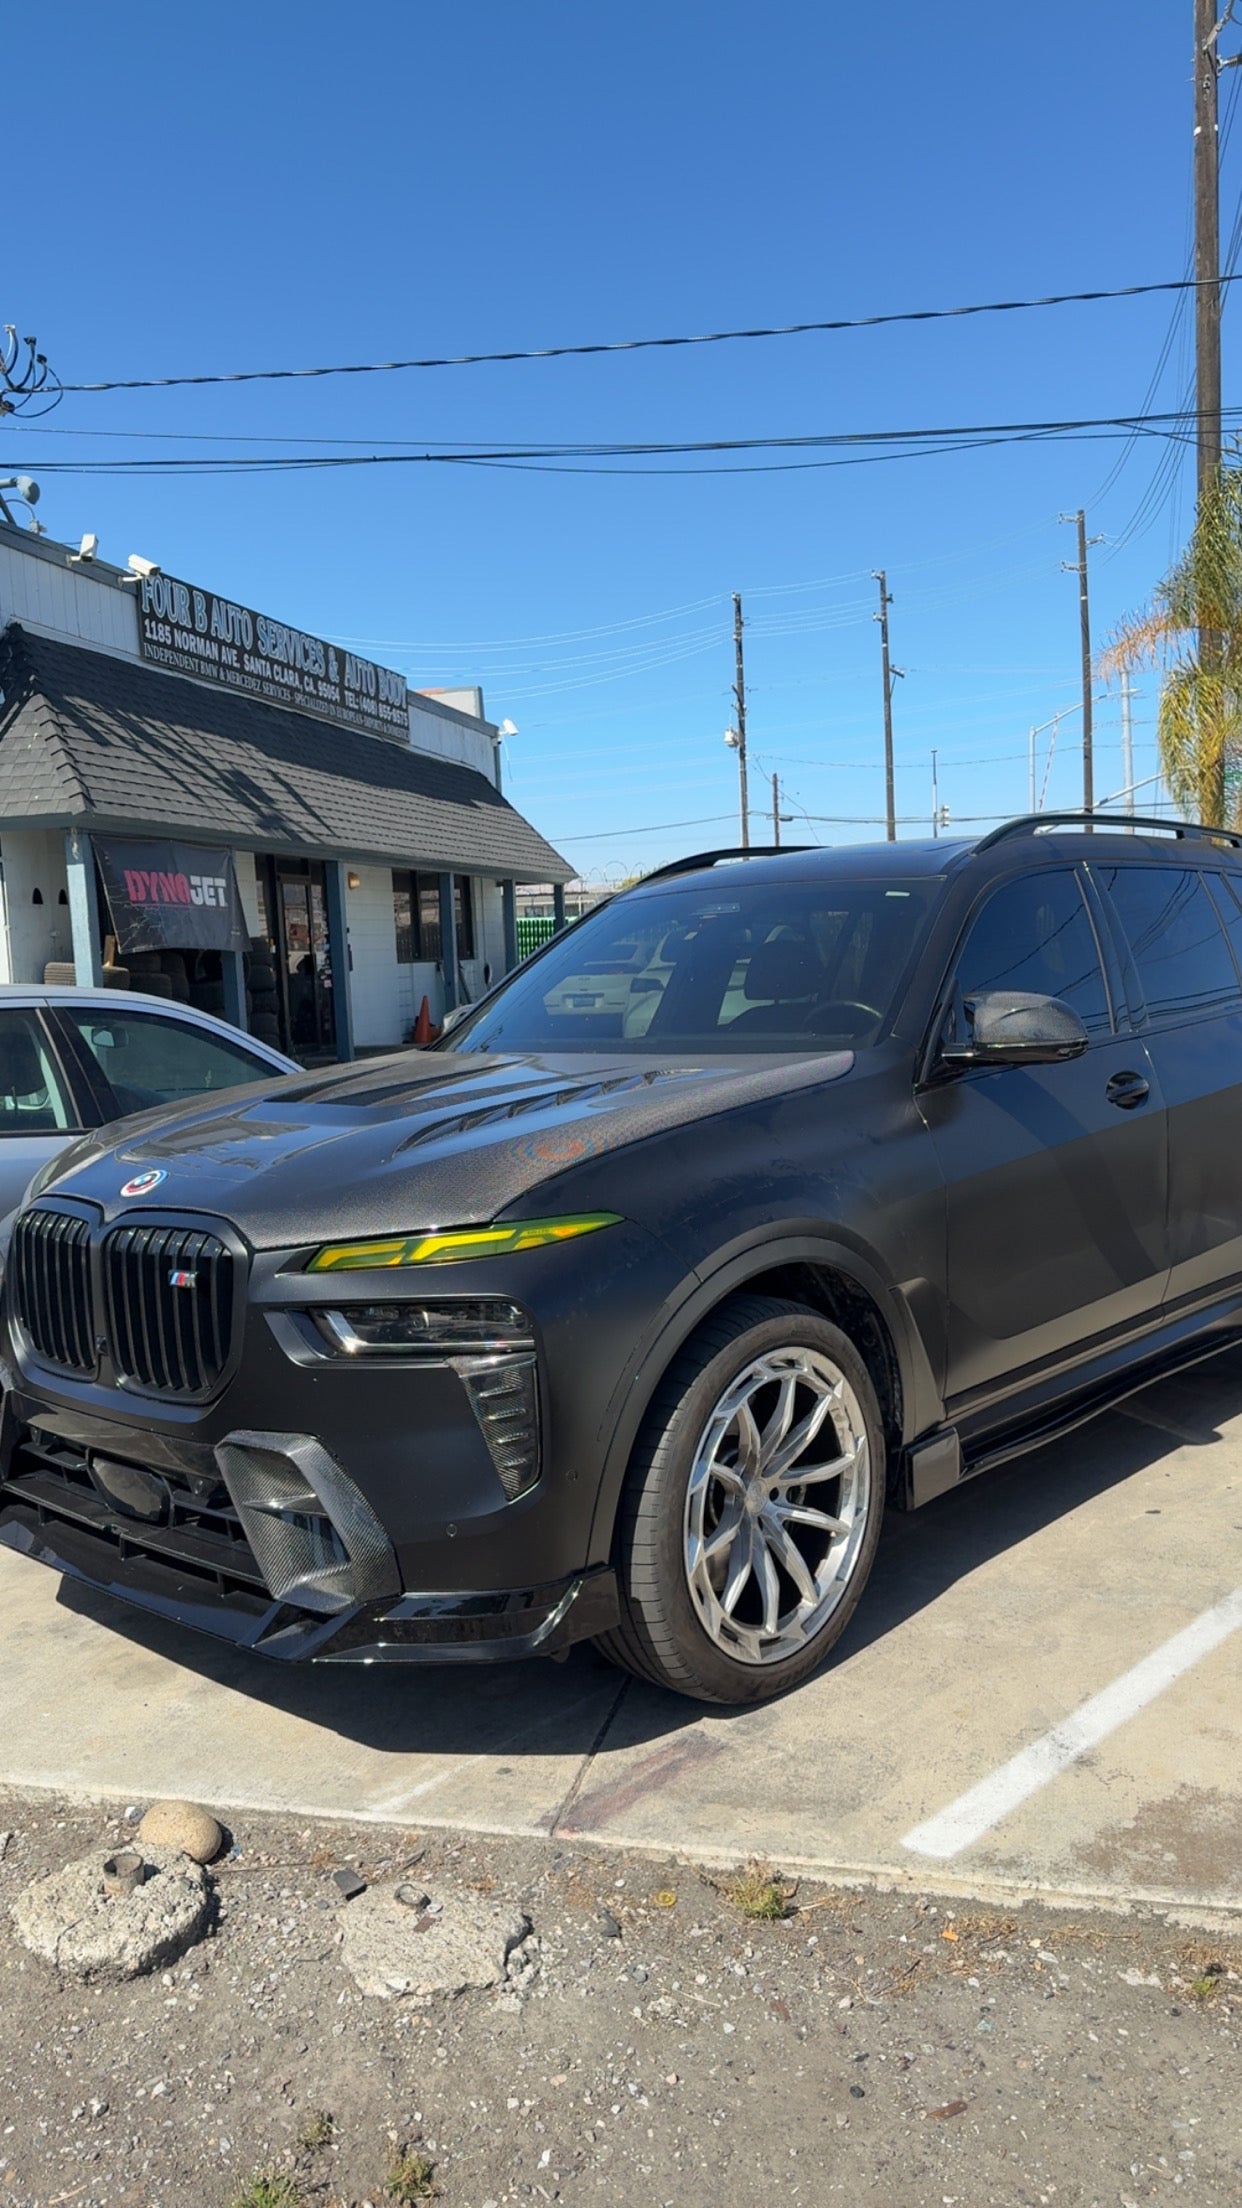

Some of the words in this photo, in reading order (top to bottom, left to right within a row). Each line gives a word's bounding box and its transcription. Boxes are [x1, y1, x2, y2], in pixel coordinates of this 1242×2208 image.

[142, 575, 192, 629] FOUR
[193, 589, 208, 633] B
[210, 597, 254, 651] AUTO
[256, 615, 326, 678] SERVICES
[328, 646, 340, 684] &
[344, 653, 377, 697] AUTO
[377, 667, 408, 710] BODY
[144, 618, 172, 645] 1185
[174, 627, 219, 661] NORMAN
[221, 645, 241, 668] AVE.
[243, 653, 272, 680] SANTA
[273, 664, 303, 693] CLARA,
[144, 643, 200, 673] INDEPENDENT
[200, 661, 219, 679] BMW
[262, 681, 291, 702] SERVICES
[123, 869, 228, 908] DYNOJET
